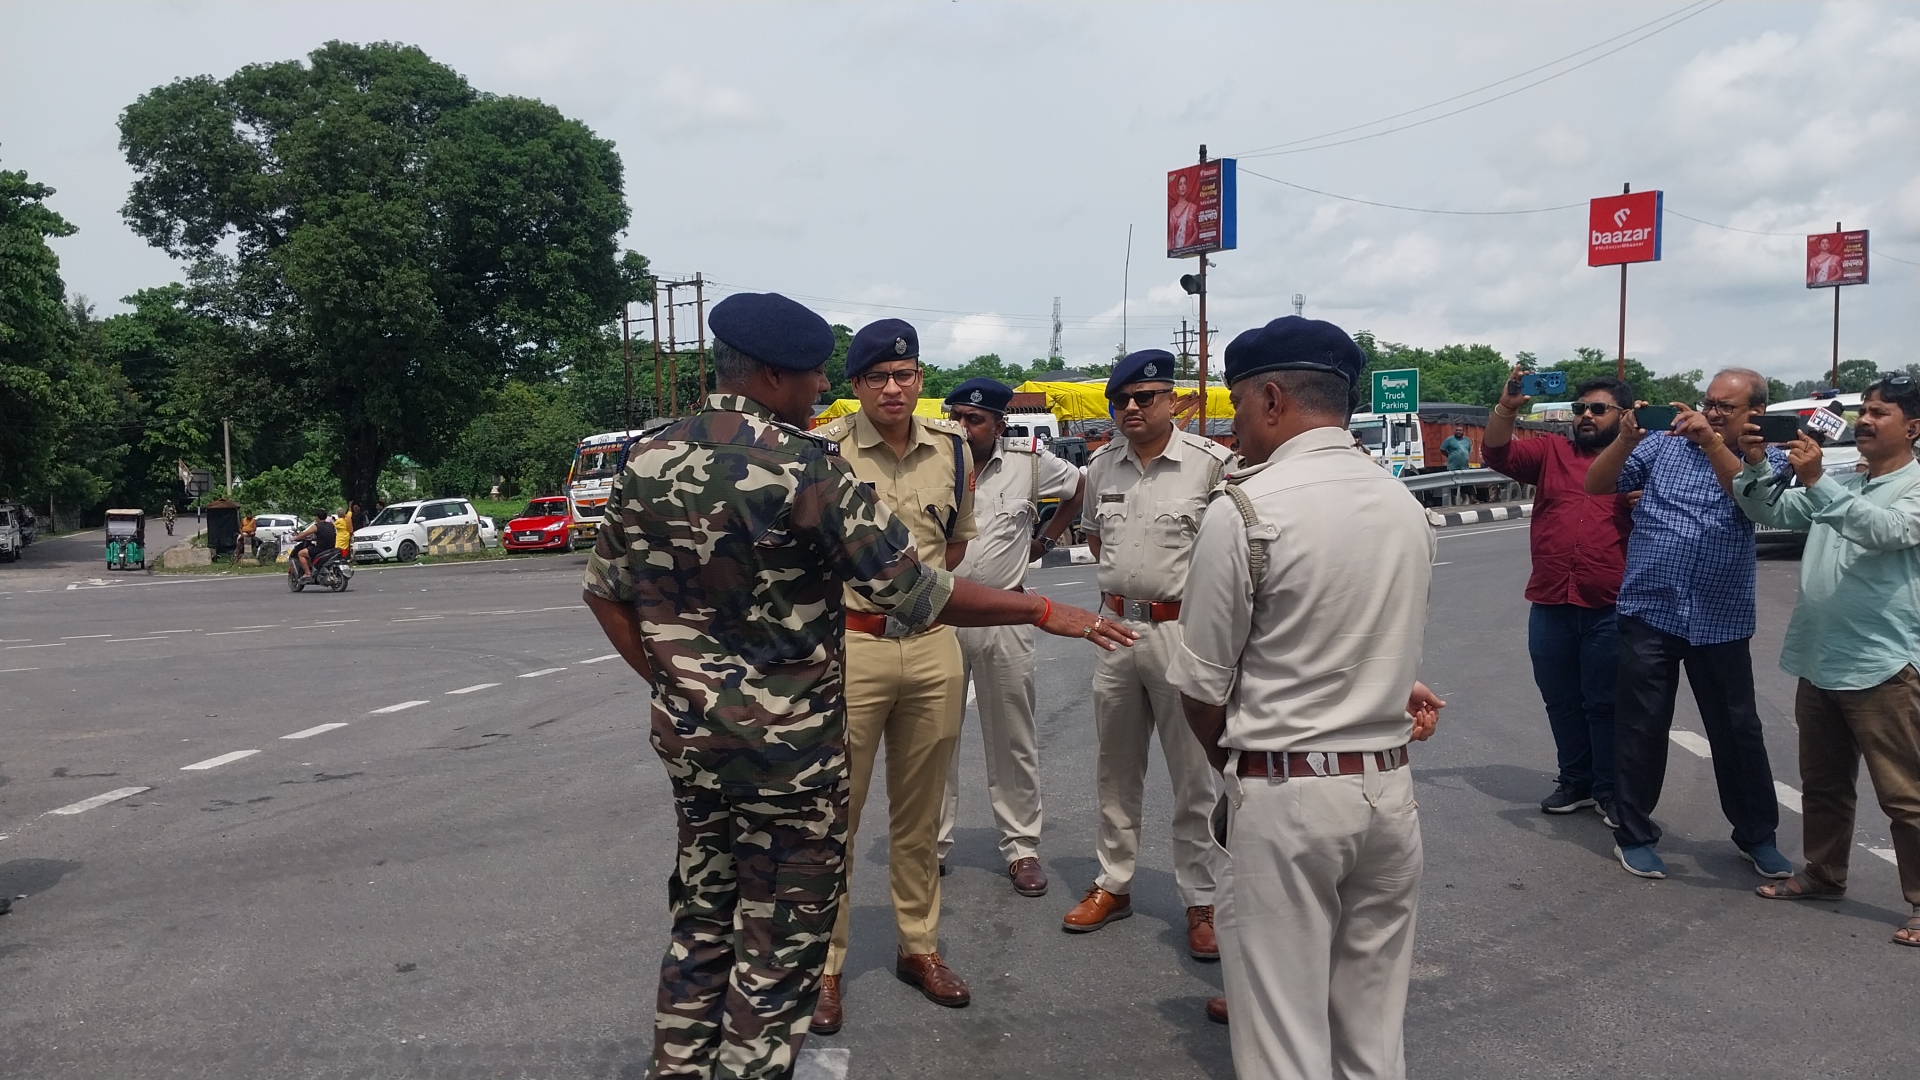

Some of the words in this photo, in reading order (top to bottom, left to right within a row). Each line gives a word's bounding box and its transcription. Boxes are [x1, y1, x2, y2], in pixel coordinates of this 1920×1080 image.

[1591, 227, 1652, 246] baazar
[1384, 391, 1406, 400] Truck
[1381, 401, 1409, 410] Parking
[1814, 417, 1838, 435] TIME
[1816, 410, 1841, 428] NEWS
[827, 442, 839, 452] IPS
